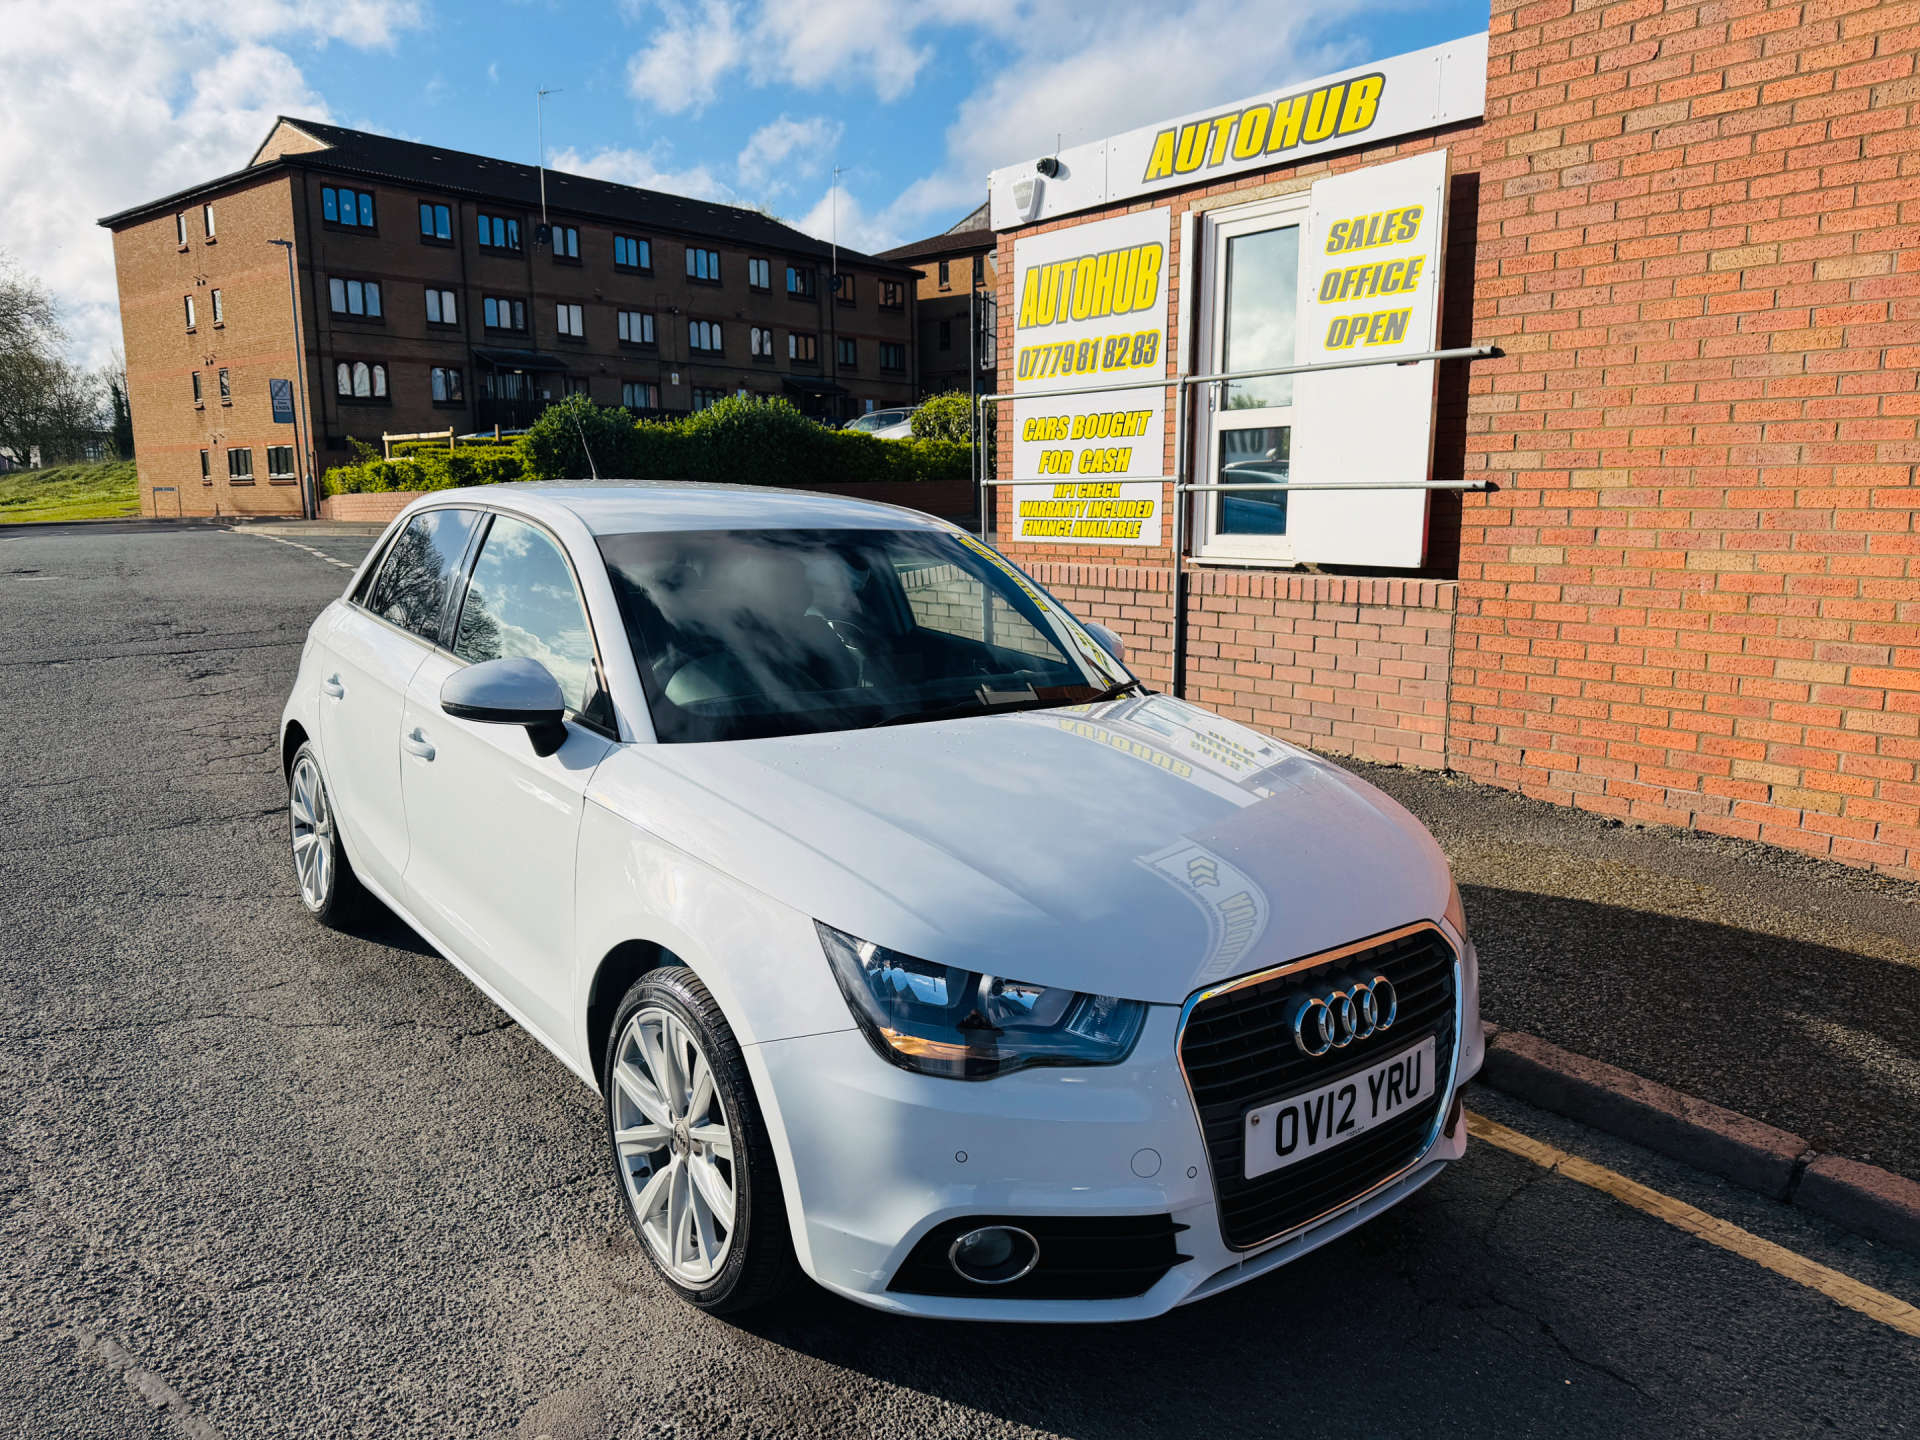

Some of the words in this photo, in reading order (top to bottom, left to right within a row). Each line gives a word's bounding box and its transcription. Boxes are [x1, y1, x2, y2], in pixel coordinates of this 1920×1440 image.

[1142, 72, 1386, 183] AUTOHUB
[1326, 206, 1423, 254] SALES
[1017, 241, 1163, 330] AUTOHUB
[1319, 256, 1424, 303] OFFICE
[1325, 308, 1412, 349] OPEN
[1022, 415, 1070, 442] CARS
[1070, 409, 1153, 440] BOUGHT
[1037, 450, 1074, 474] FOR
[1078, 447, 1132, 474] CASH
[1019, 500, 1088, 518] WARRANTY
[1086, 500, 1155, 518] INCLUDED
[1053, 483, 1077, 498] HPI
[1076, 482, 1122, 498] CHECK
[1021, 519, 1073, 537] FINANCE
[1071, 519, 1142, 538] AVAILABLE
[1275, 1083, 1357, 1157] OV12
[1367, 1050, 1422, 1118] YRU
